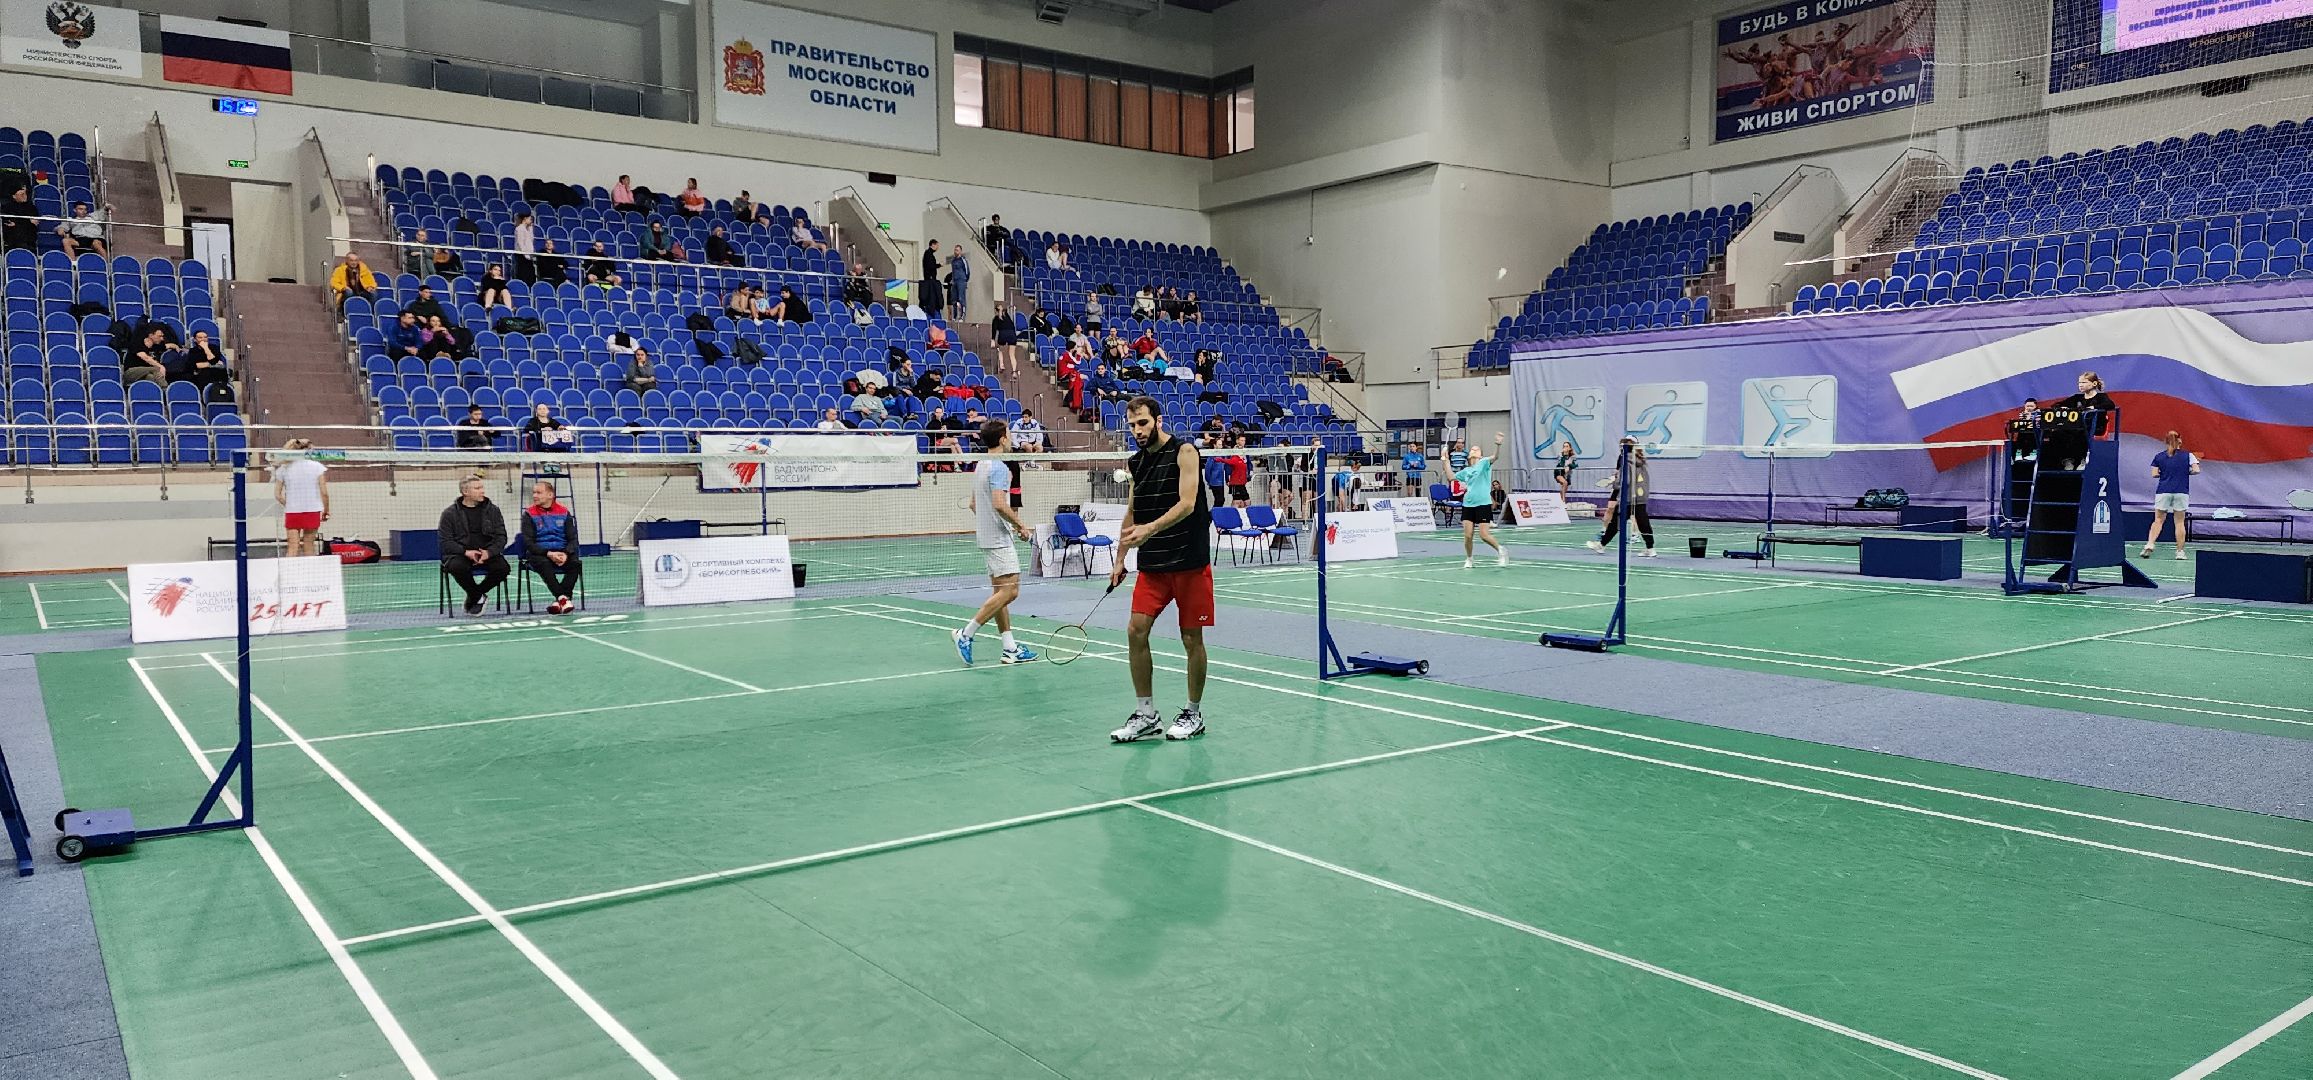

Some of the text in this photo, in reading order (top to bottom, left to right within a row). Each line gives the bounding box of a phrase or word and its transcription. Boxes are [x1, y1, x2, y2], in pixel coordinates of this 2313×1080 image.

[1740, 11, 1788, 35] БУДЬ
[1797, 5, 1808, 21] В
[2195, 8, 2216, 20] Дню
[2227, 30, 2255, 42] ВРЕМЯ
[23, 54, 122, 70] РОССИЙСКОЙ ФЕДЕРАЦИИ
[26, 48, 117, 64] МИНИСТЕРСТВО СПОРТА
[771, 39, 929, 79] ПРАВИТЕЛЬСТВО
[788, 64, 915, 97] МОСКОВСКОЙ
[810, 89, 896, 115] ОБЛАСТИ
[1737, 83, 1917, 132] ЖИВИ СПОРТОМ
[2044, 411, 2054, 422] 0
[2068, 411, 2078, 422] 0
[774, 464, 839, 473] БАДМИНТОНА
[775, 474, 810, 483] РОССИИ
[2098, 477, 2107, 497] 2
[691, 557, 785, 568] СПОРТИВНЫЙ КОМПЛЕКС
[250, 600, 332, 621] 25 ЛЕТ
